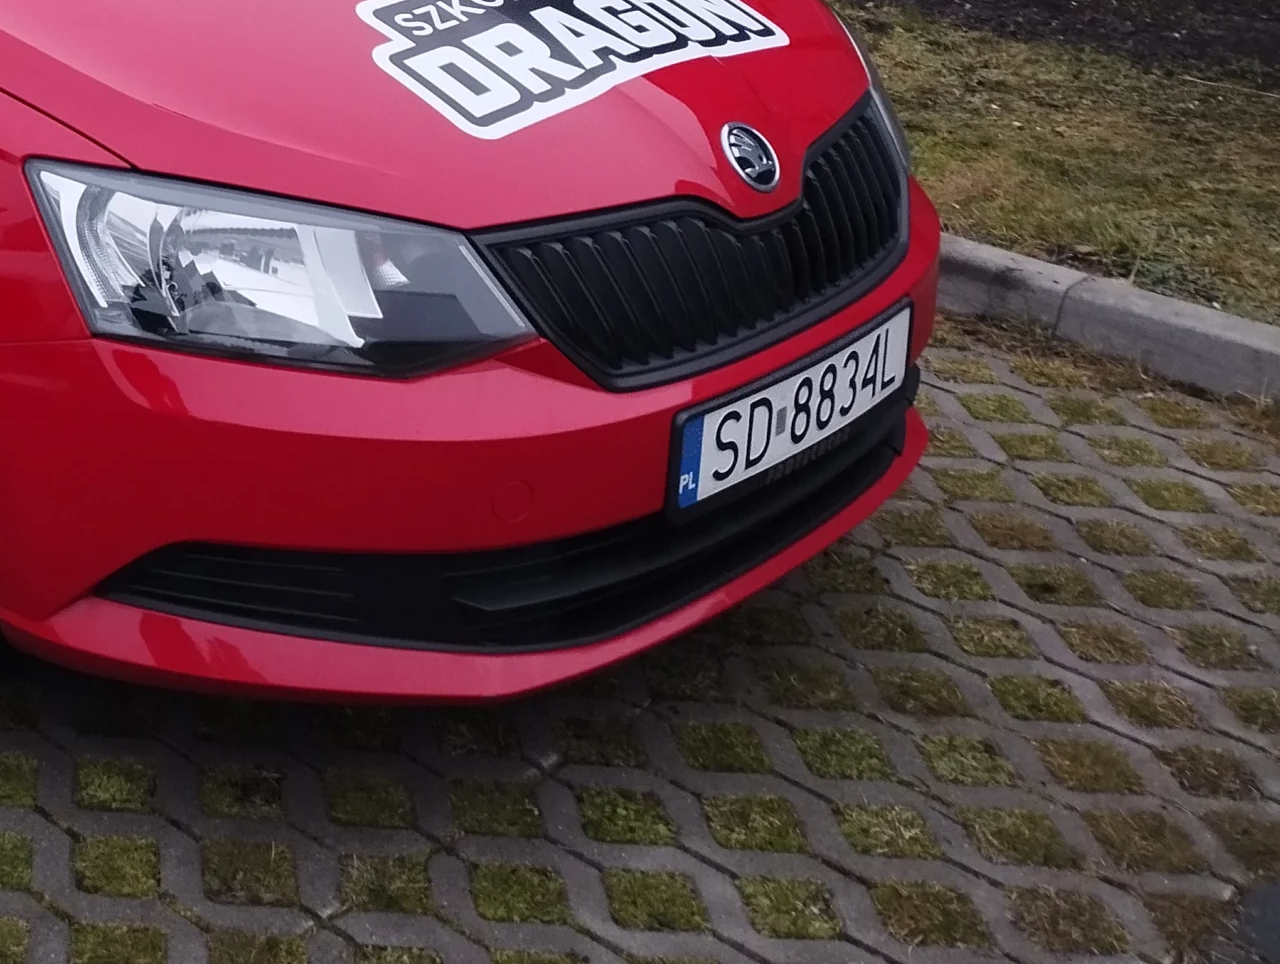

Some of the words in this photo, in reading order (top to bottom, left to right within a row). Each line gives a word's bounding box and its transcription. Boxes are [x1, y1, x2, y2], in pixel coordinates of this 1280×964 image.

[712, 397, 773, 481] SD
[790, 328, 896, 444] 8834L
[679, 471, 696, 495] PL
